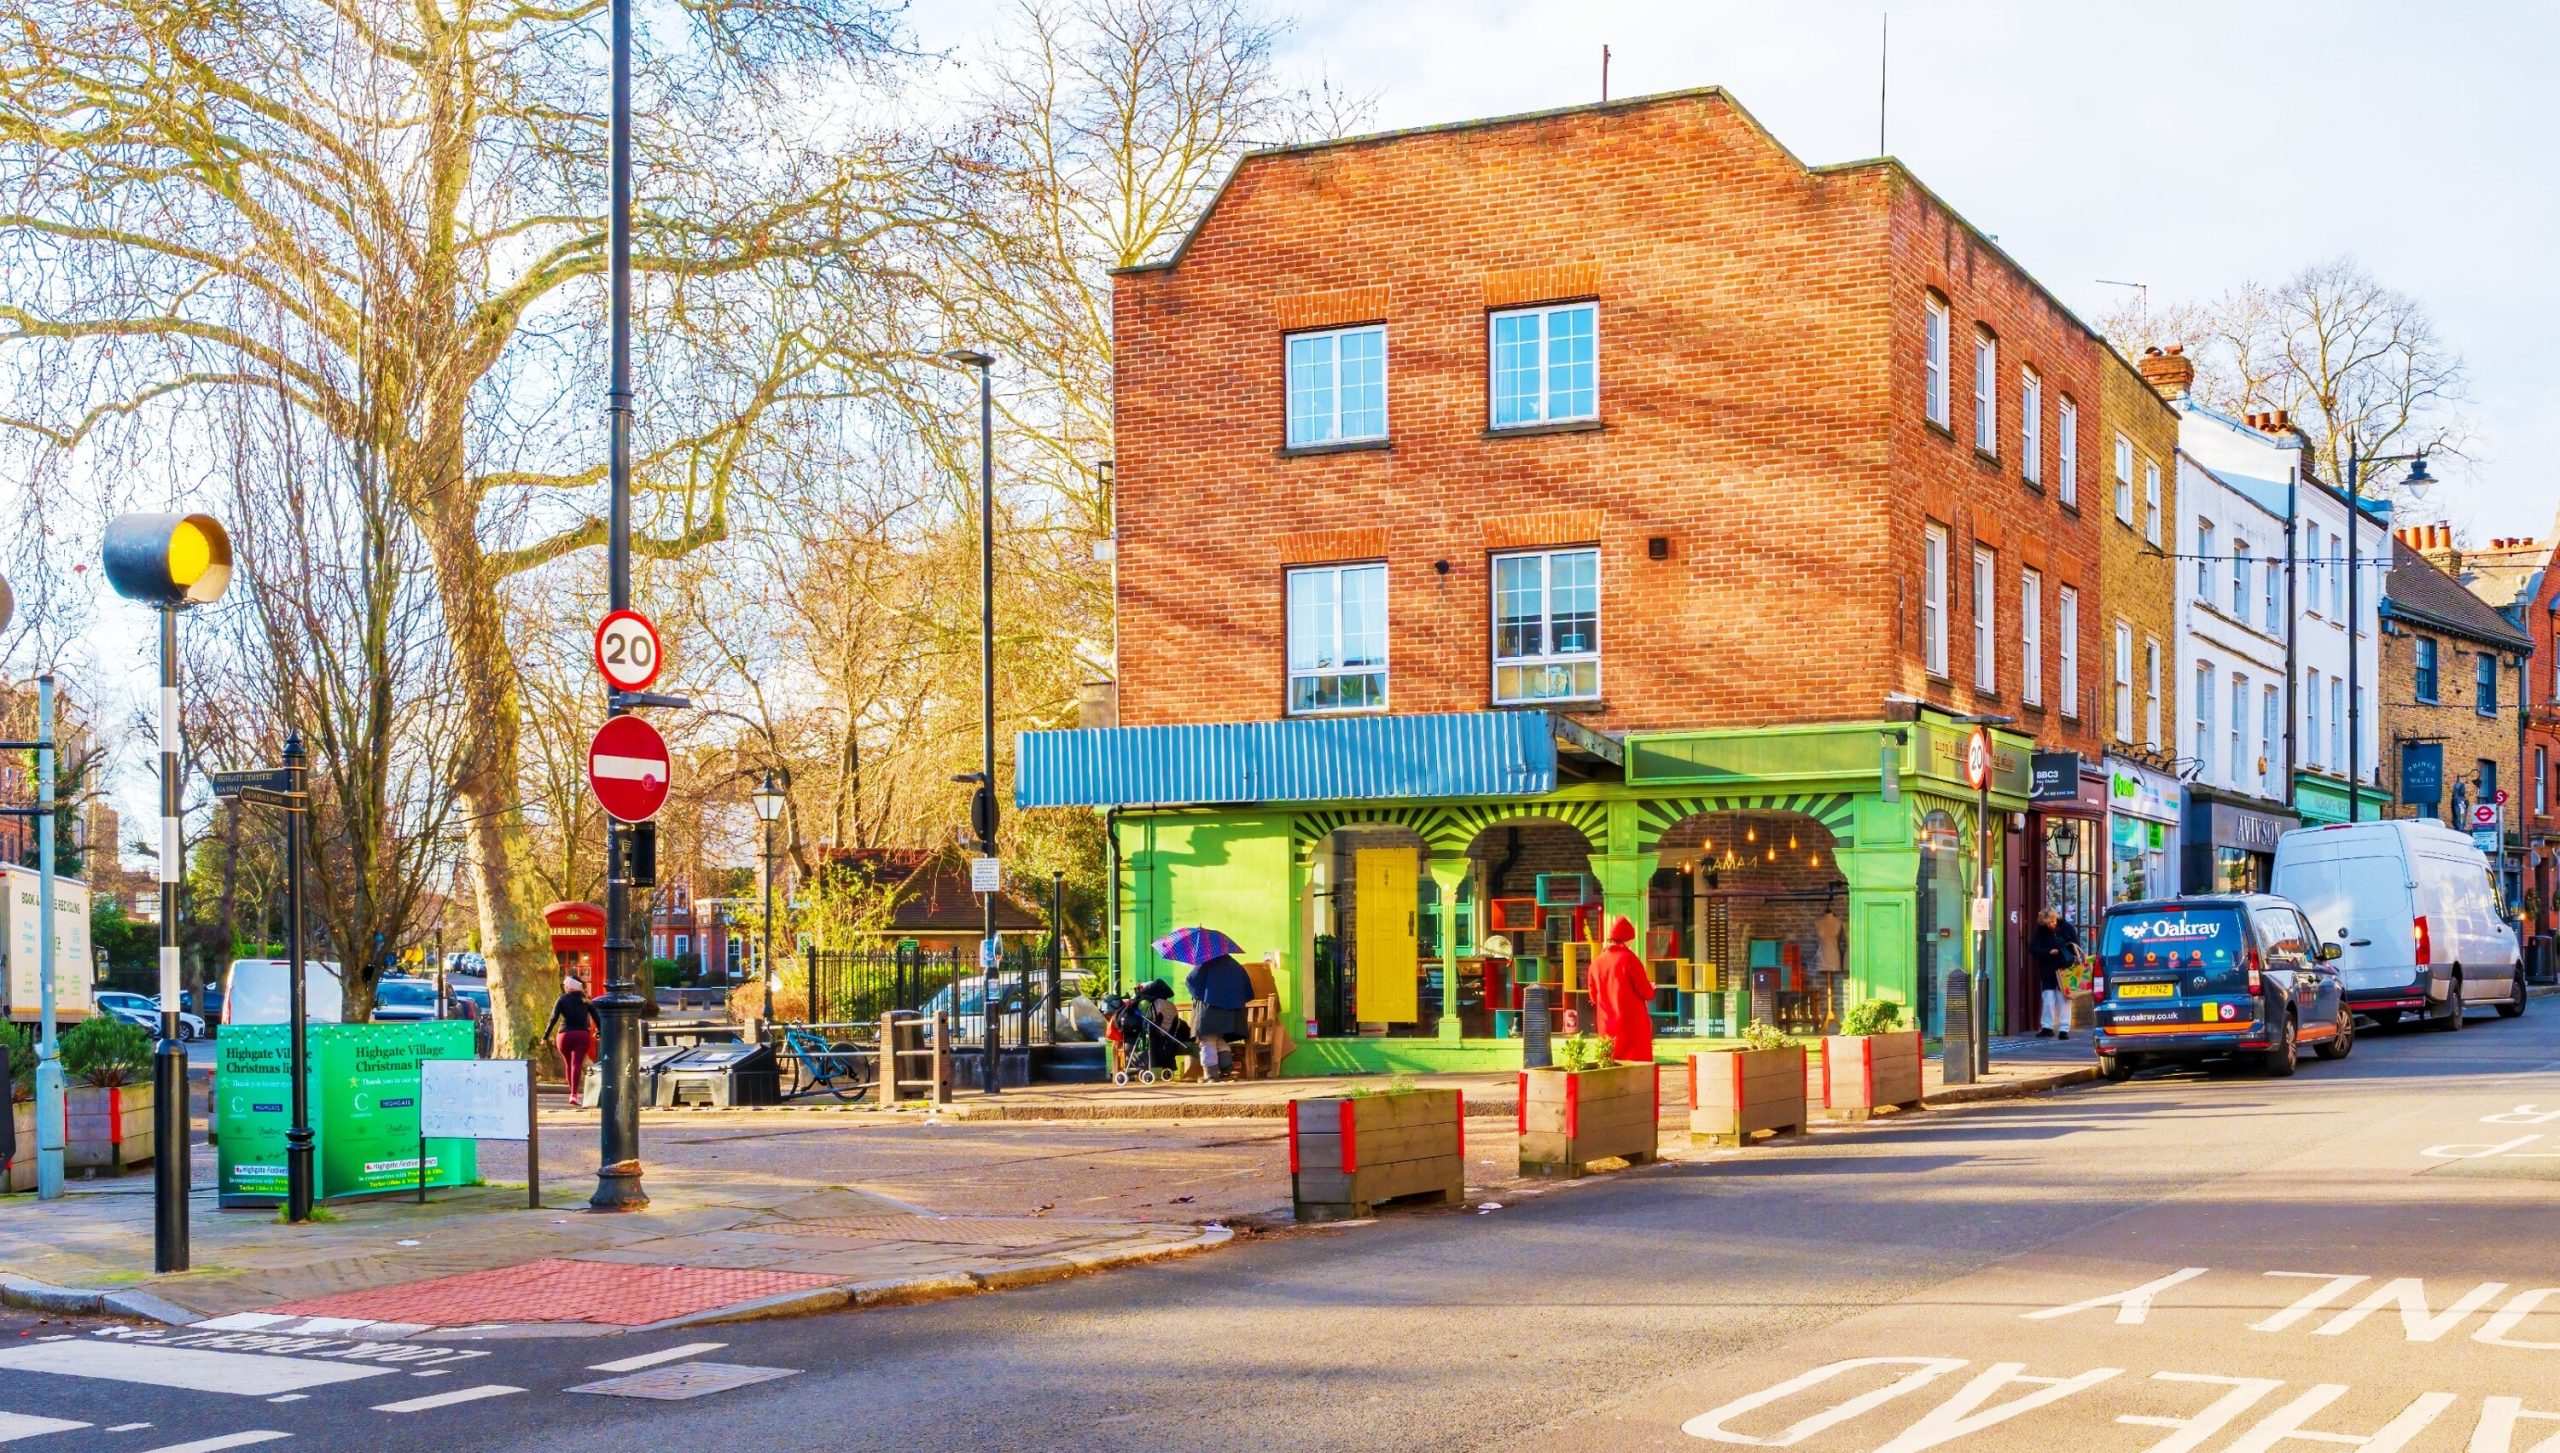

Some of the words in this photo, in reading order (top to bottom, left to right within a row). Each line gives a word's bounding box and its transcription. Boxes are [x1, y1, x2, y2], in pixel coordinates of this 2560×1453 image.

[607, 632, 651, 668] 20
[1970, 745, 1983, 770] 20
[2407, 761, 2437, 772] PRINCE
[2496, 791, 2504, 800] S
[2237, 815, 2281, 847] AVIVSON
[21, 891, 35, 906] BOOK
[551, 927, 597, 935] TELEPHONE
[2153, 919, 2220, 938] Oakray
[2122, 986, 2146, 996] LP72
[2150, 985, 2169, 995] HNZ
[2113, 1011, 2178, 1022] www.oakray.co.uk
[226, 1047, 273, 1061] Highgate
[356, 1045, 406, 1060] Highgate
[408, 1044, 444, 1057] Village
[226, 1062, 280, 1074] Christmas
[356, 1060, 412, 1073] Christmas
[232, 1080, 250, 1088] Thank
[250, 1081, 261, 1089] you
[363, 1078, 381, 1086] Thank
[382, 1078, 393, 1086] you
[508, 1083, 525, 1098] N6
[242, 1166, 266, 1175] Highgate
[373, 1161, 398, 1170] Highgate
[399, 1160, 418, 1168] Festive
[136, 1331, 352, 1355] RIGHT
[304, 1341, 492, 1367] LOOK
